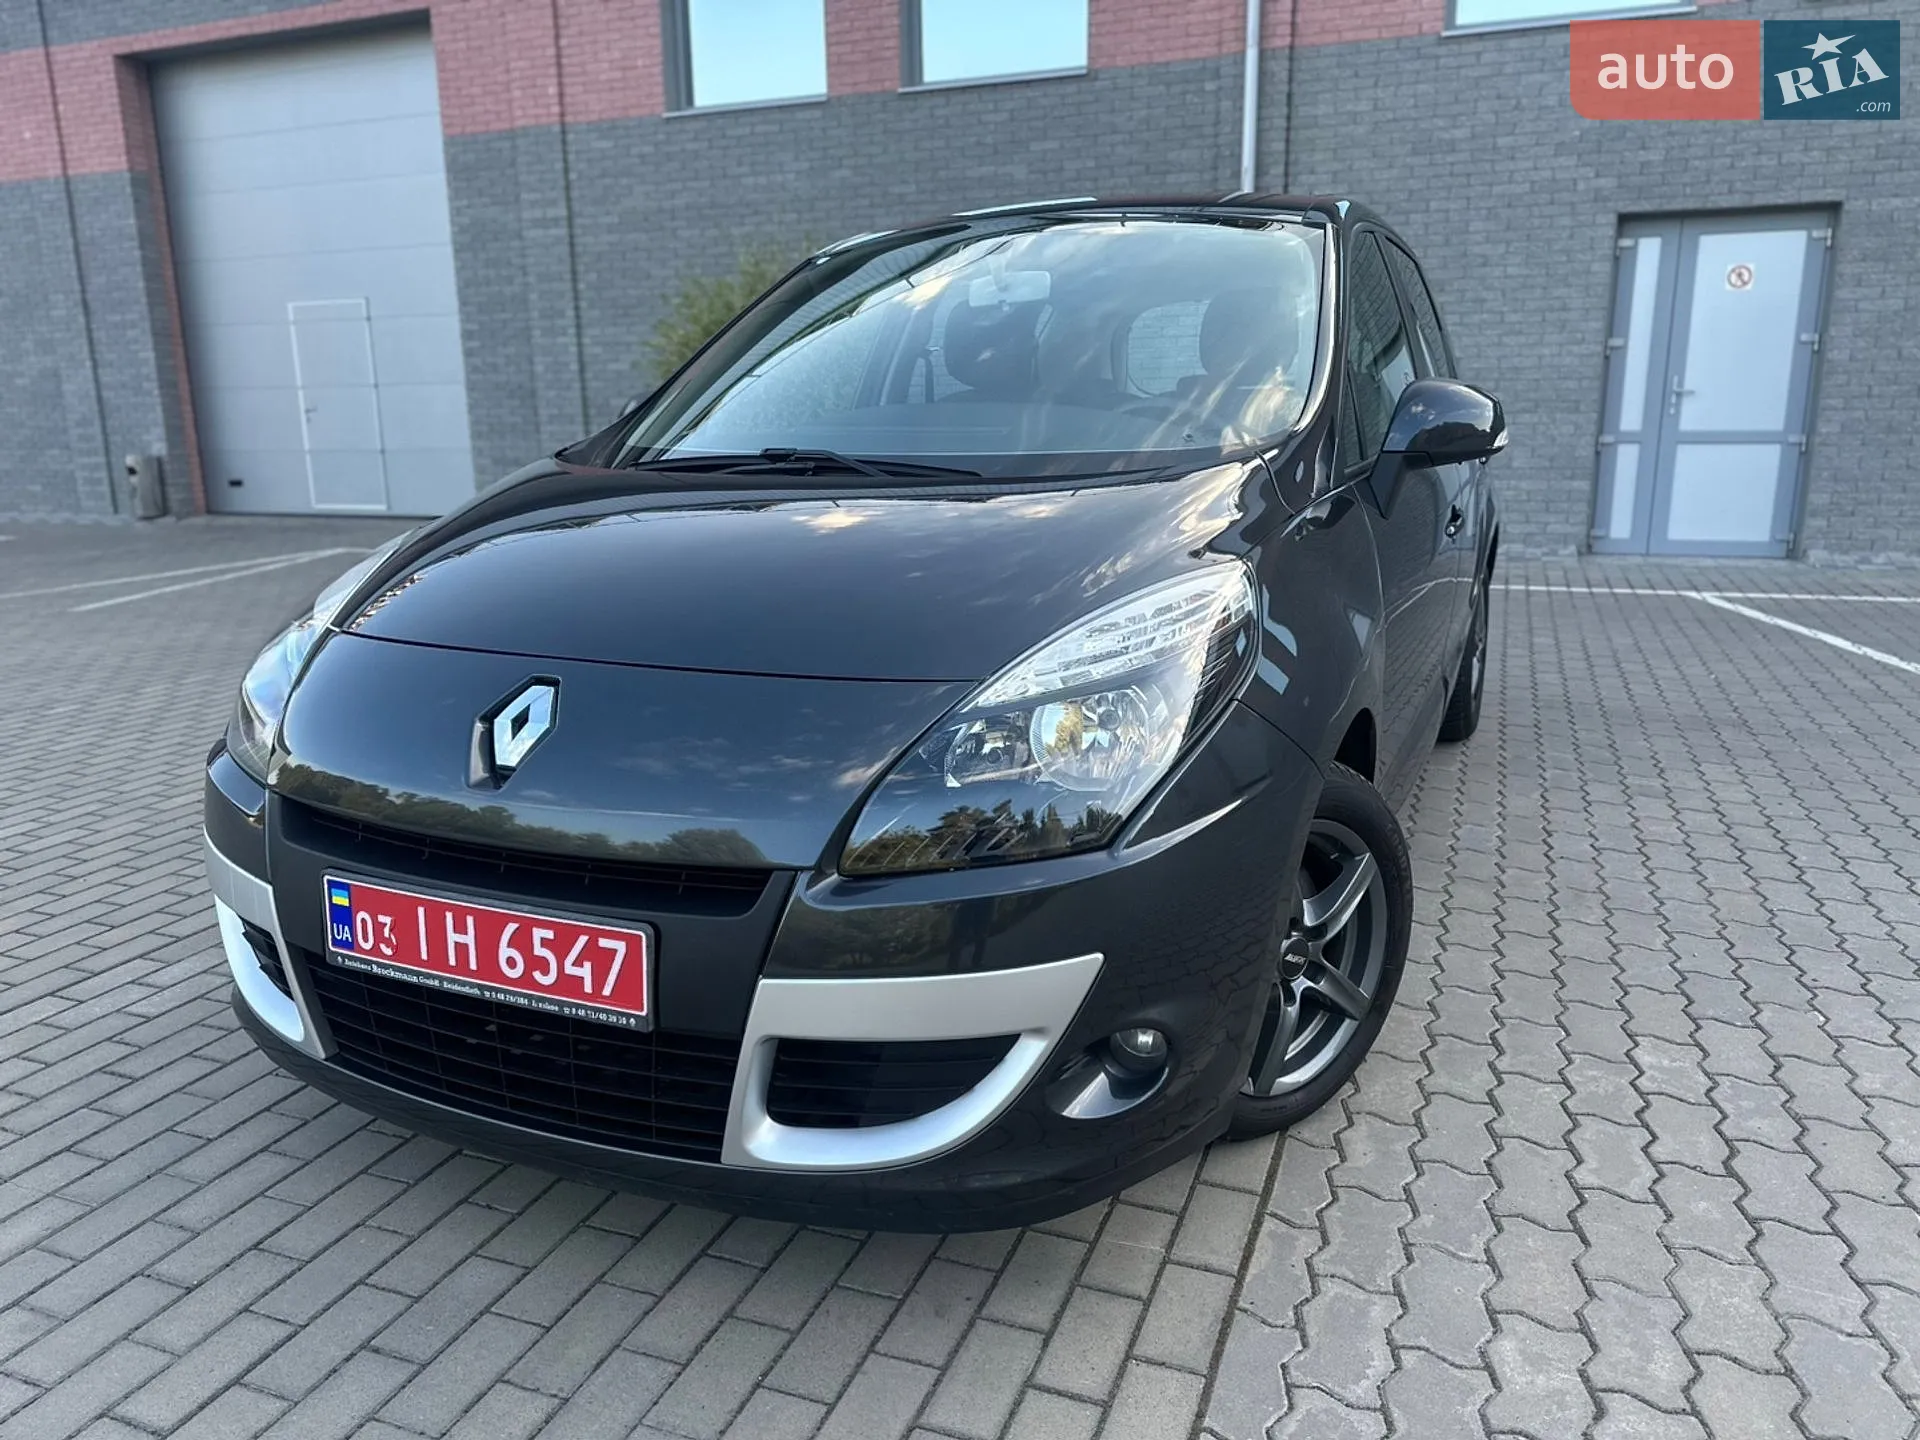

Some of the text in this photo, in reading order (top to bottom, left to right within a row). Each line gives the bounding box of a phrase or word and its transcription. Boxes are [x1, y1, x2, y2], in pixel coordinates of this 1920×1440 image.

[333, 922, 352, 943] UA
[355, 910, 398, 956] 03
[498, 922, 627, 997] 6547
